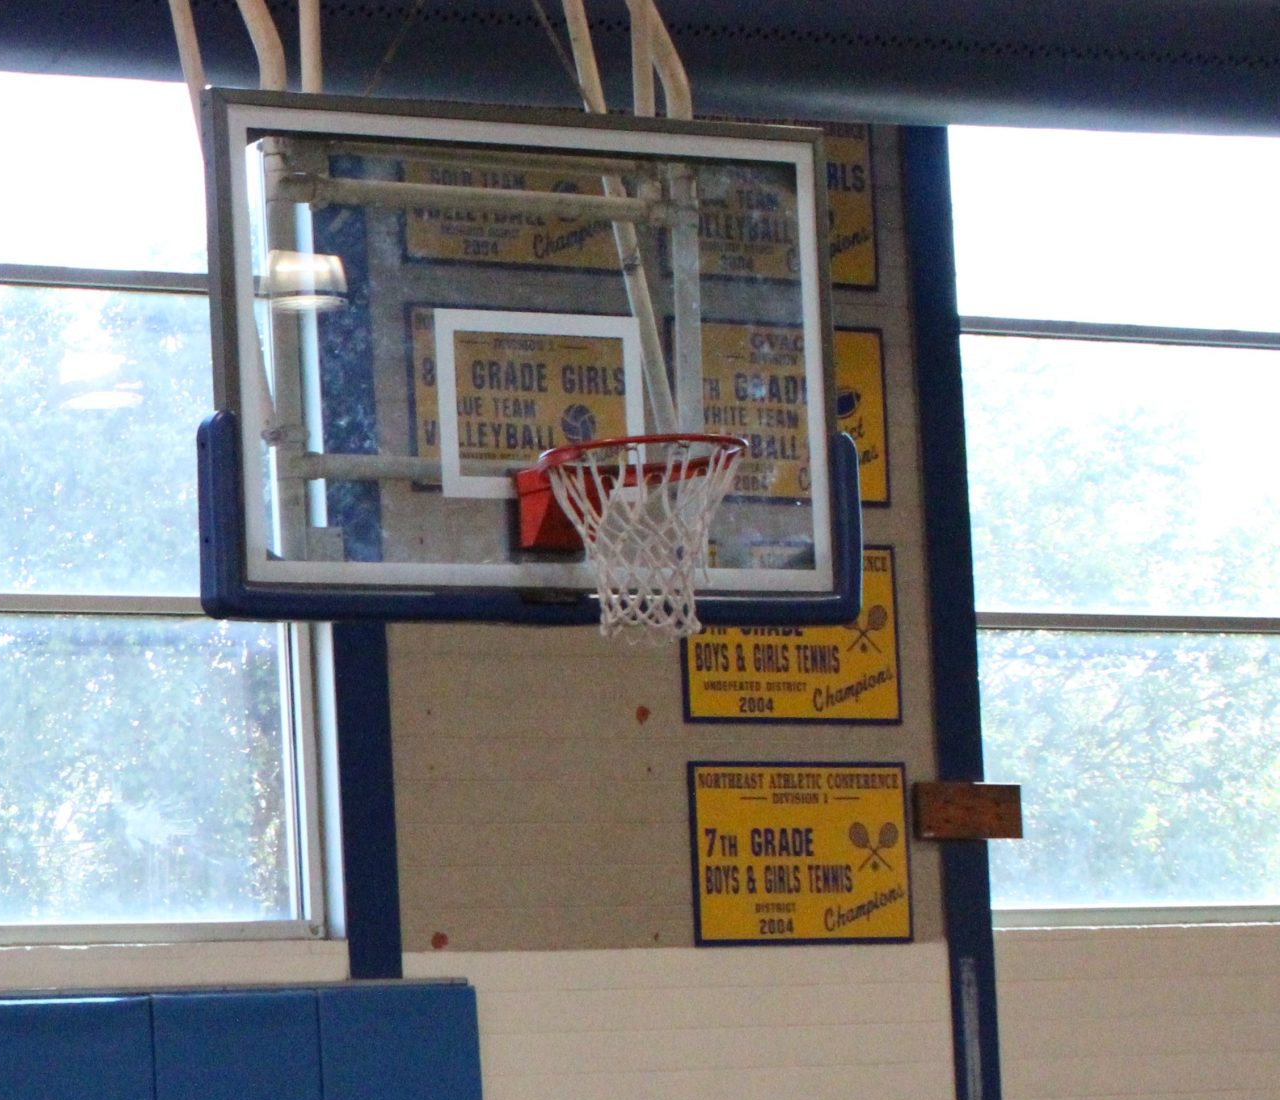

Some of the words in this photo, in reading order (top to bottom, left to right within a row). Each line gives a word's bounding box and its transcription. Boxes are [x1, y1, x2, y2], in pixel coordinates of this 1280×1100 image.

[472, 360, 549, 393] GRADE
[561, 364, 626, 395] GIRLS
[494, 399, 536, 419] TEAM
[757, 410, 799, 428] TEAM
[695, 643, 729, 672] BOYS
[736, 643, 746, 672] &
[754, 644, 790, 673] GIRLS
[795, 645, 841, 674] TENNIS
[704, 681, 761, 692] UNDEFEATED
[766, 682, 807, 692] DISTRICT
[813, 666, 893, 712] Champions
[739, 697, 774, 713] 2004
[698, 773, 764, 790] NORTHEAST
[769, 773, 821, 789] ATHLETIC
[827, 773, 899, 789] CONFERENCE
[773, 793, 819, 804] DIVISION
[705, 828, 738, 858] 7TH
[751, 828, 814, 857] GRADE
[705, 865, 740, 895] BOYS
[746, 865, 757, 894] &
[764, 865, 801, 894] GIRLS
[808, 864, 853, 893] TENNIS
[755, 903, 796, 913] DISTRICT
[824, 883, 904, 932] Champions
[760, 919, 794, 934] 2004
